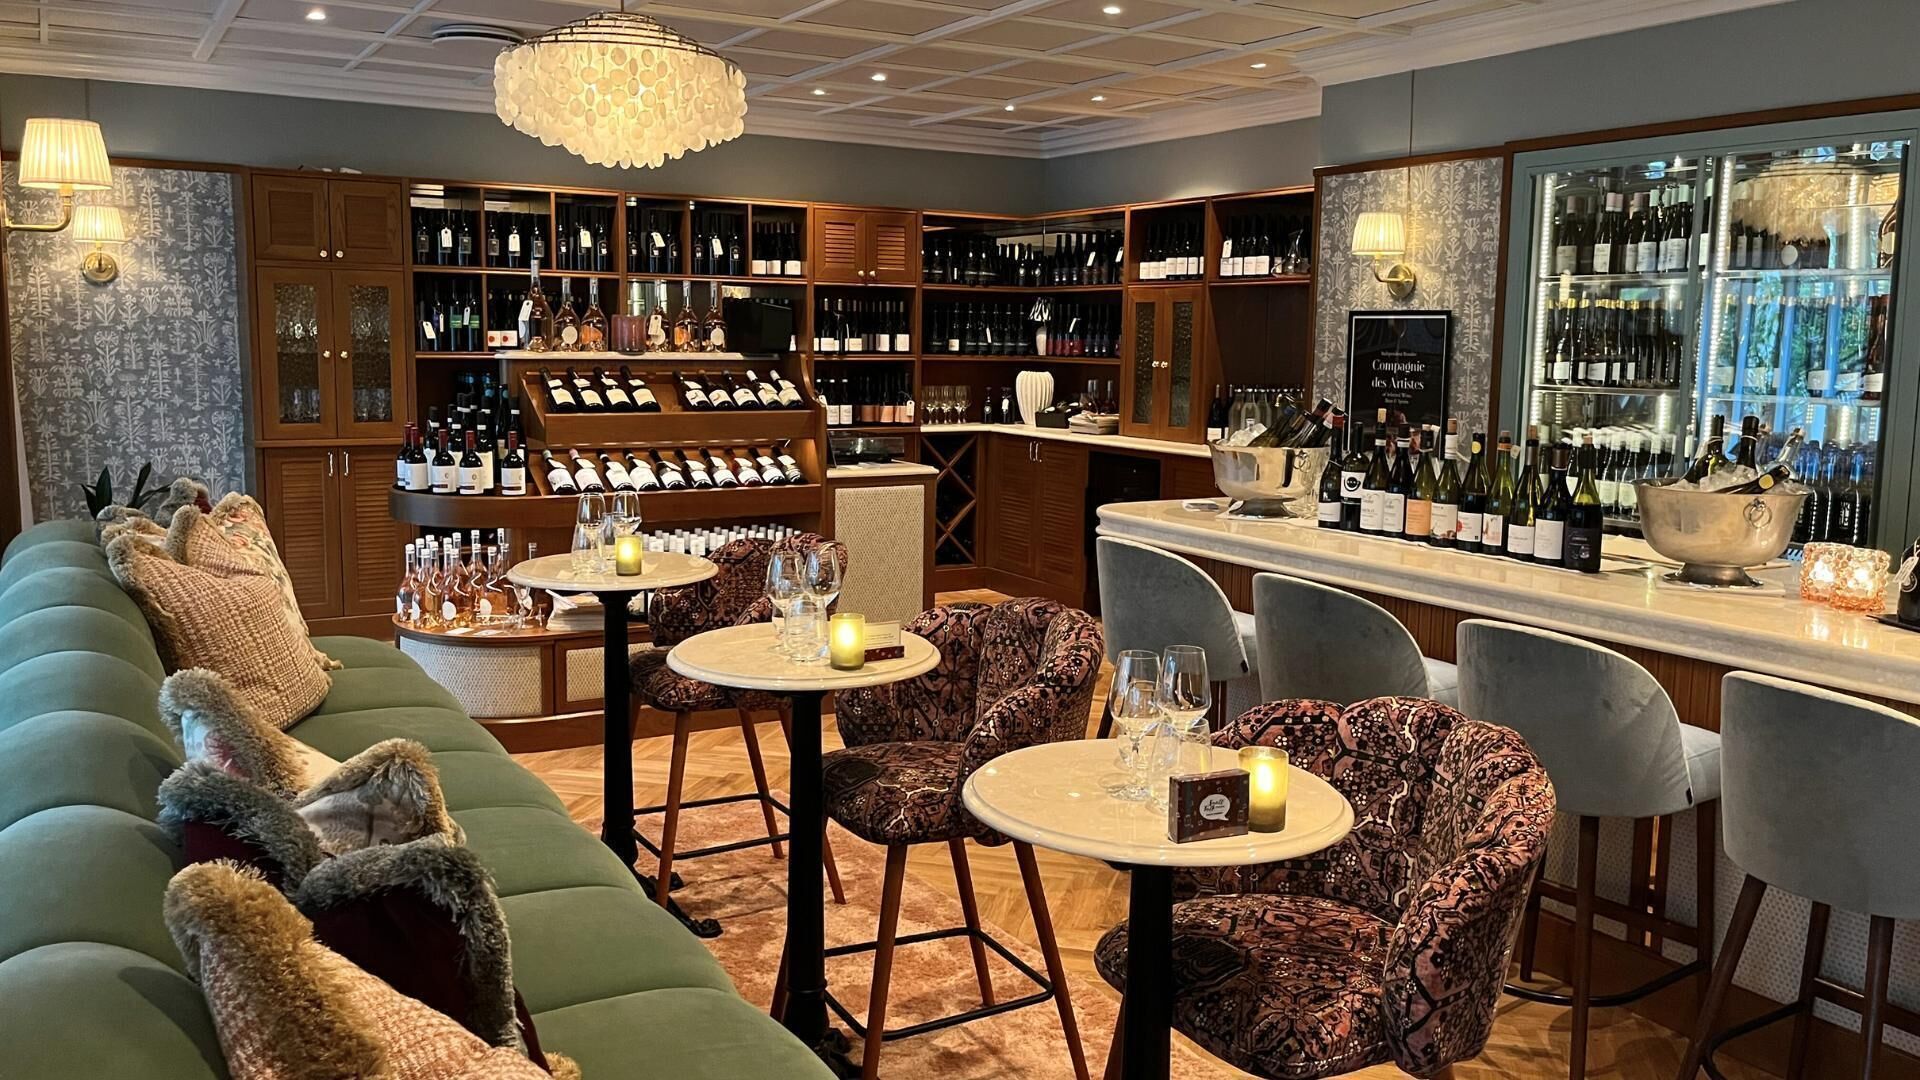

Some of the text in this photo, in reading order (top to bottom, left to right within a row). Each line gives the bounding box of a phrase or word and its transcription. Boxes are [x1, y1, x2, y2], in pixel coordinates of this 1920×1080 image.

[1372, 359, 1425, 374] Compagnie
[1371, 376, 1425, 390] des Artistes
